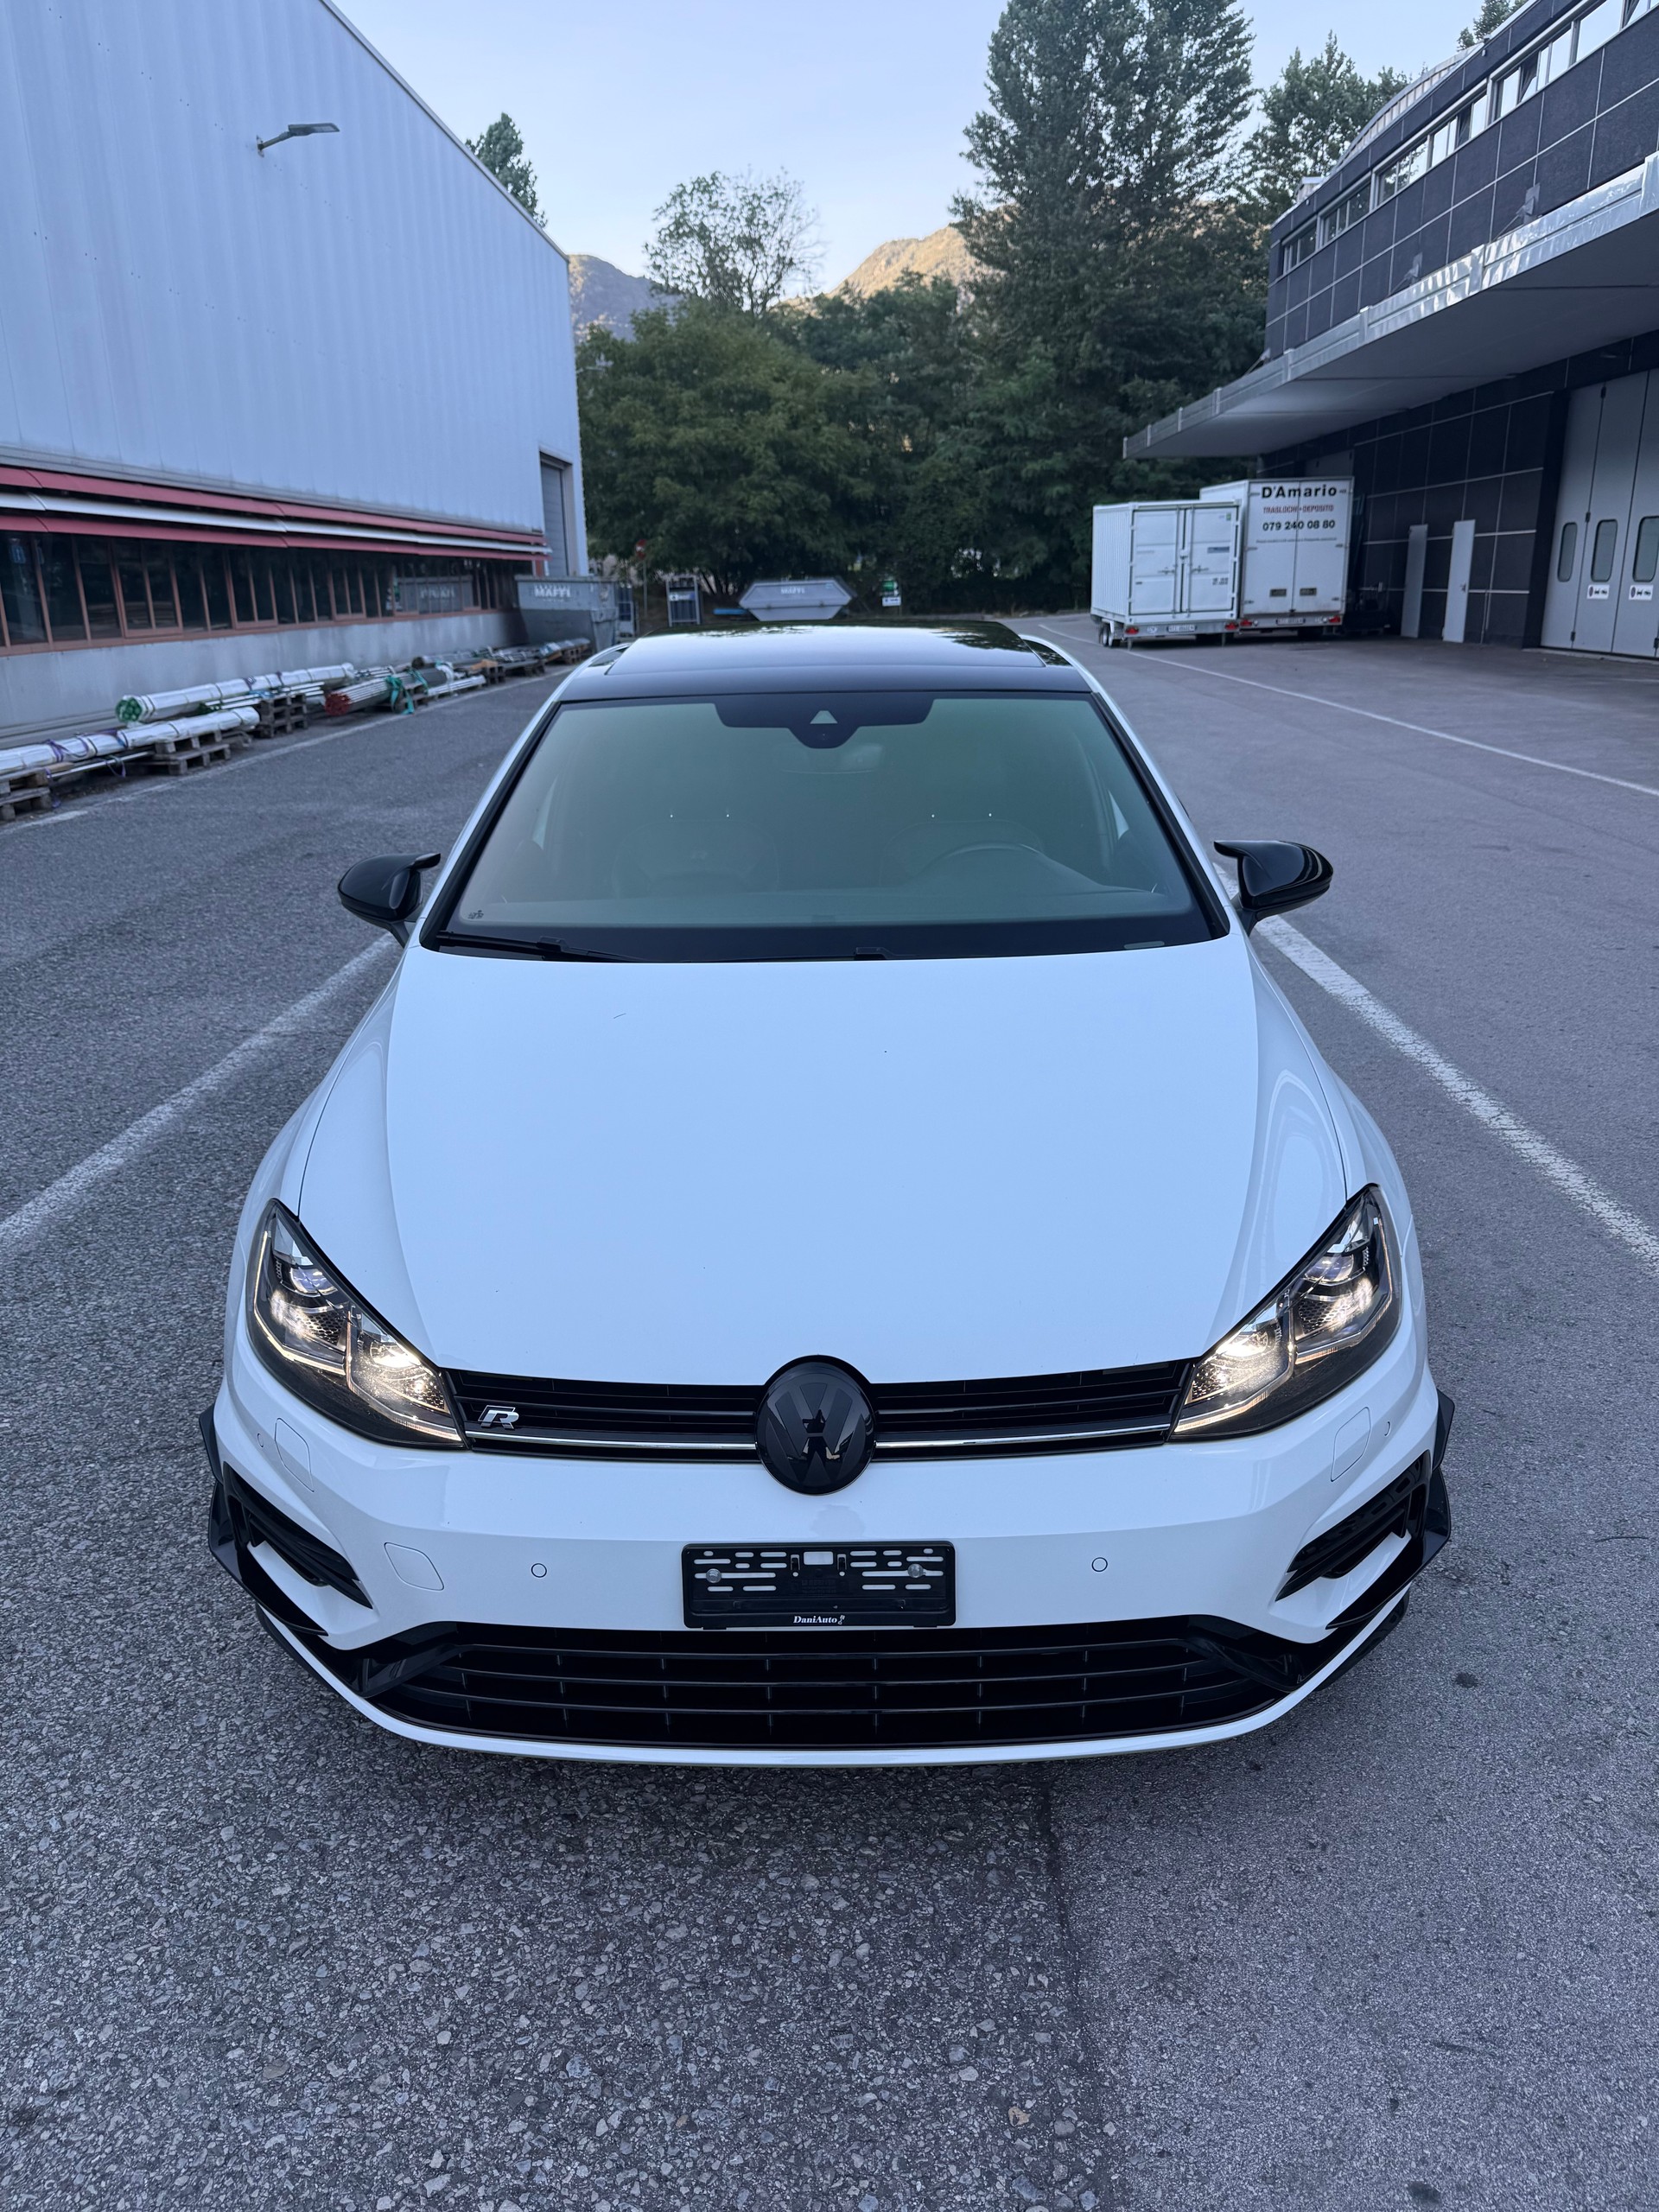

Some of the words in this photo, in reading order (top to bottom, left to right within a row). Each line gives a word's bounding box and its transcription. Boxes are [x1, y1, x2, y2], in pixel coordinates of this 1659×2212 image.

[1262, 484, 1337, 498] D'Amario
[1262, 521, 1281, 531] 079
[1284, 520, 1305, 531] 240
[1307, 519, 1319, 530] 08
[1322, 519, 1336, 530] 80
[478, 1404, 519, 1429] R
[793, 1615, 837, 1624] DaniAuto
